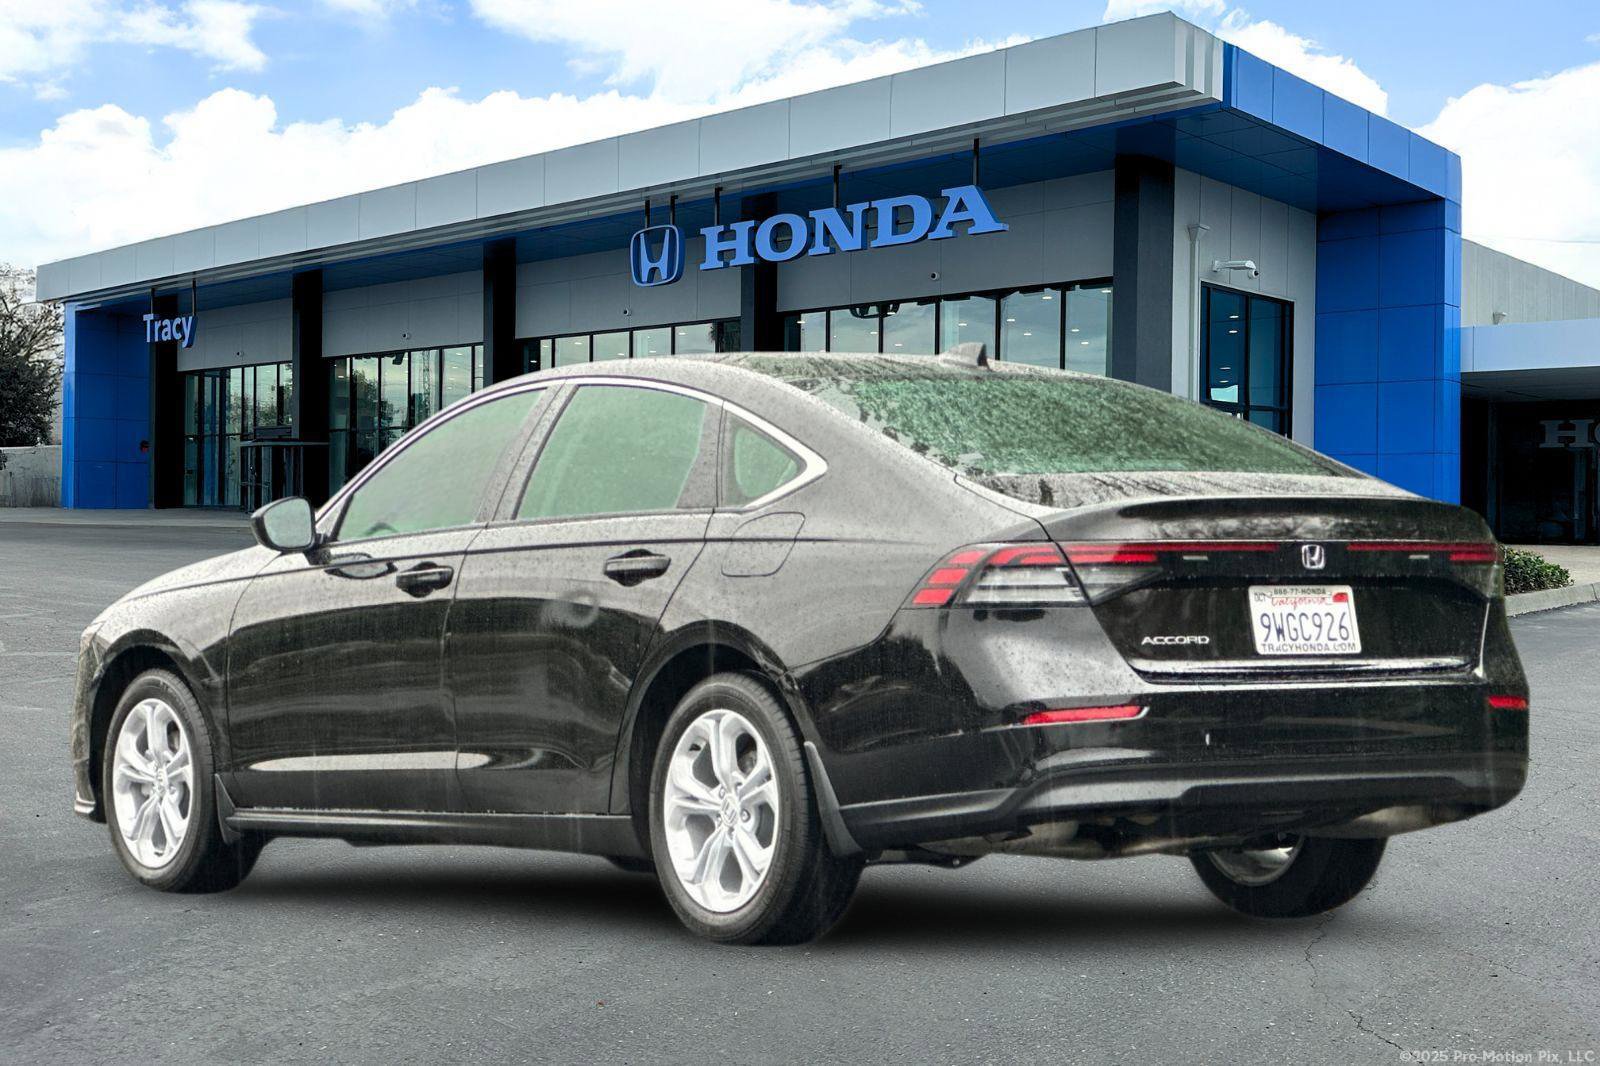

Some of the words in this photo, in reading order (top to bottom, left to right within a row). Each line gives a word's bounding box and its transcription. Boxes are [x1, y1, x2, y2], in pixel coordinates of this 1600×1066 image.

[699, 184, 1010, 271] HONDA
[142, 313, 194, 349] Tracy
[1141, 635, 1210, 645] ACCORD
[1260, 612, 1350, 642] 9WGC926
